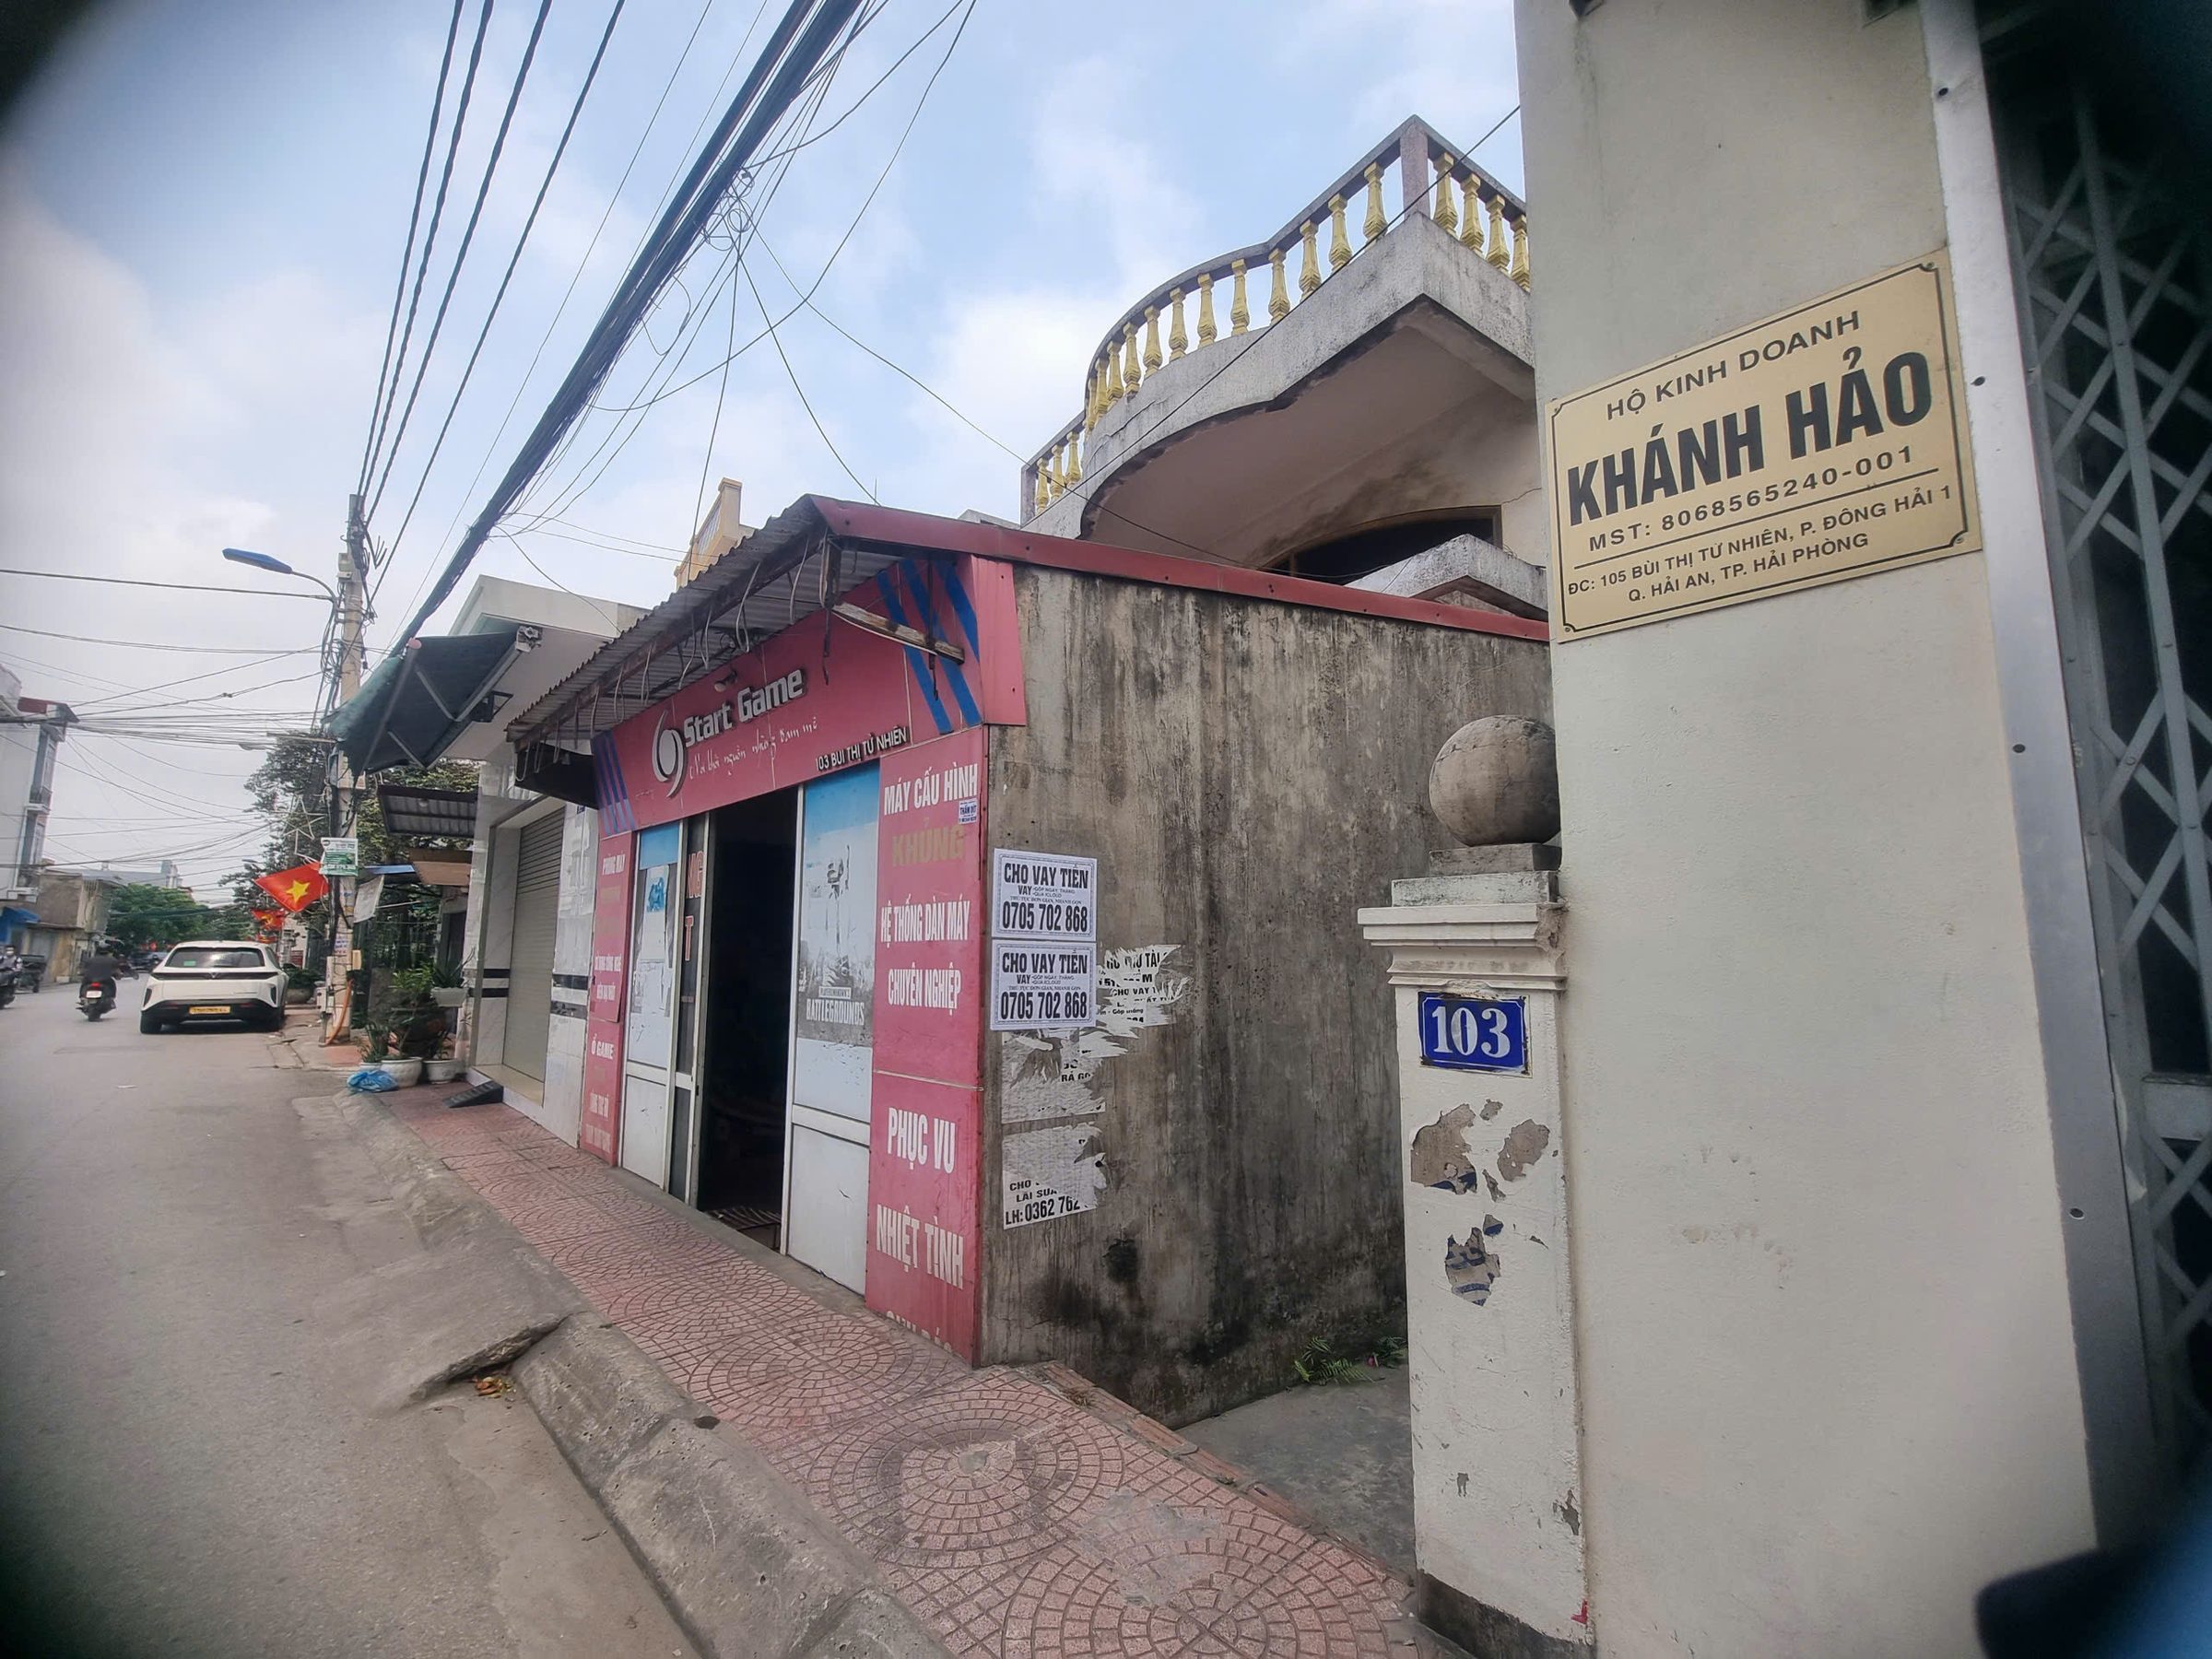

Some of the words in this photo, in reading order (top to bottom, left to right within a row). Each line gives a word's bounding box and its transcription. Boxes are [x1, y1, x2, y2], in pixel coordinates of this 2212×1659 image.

[1606, 387, 1647, 421] HỘ
[1655, 359, 1728, 403] KINH
[1738, 310, 1861, 372] DOANH
[1567, 404, 1765, 527] KHÁNH
[1784, 346, 1933, 461] HẢO
[1589, 523, 1651, 552] MST:
[1661, 445, 1911, 531] 8068565240-001
[1568, 579, 1596, 595] ĐC:
[1600, 570, 1628, 588] 105
[1631, 559, 1660, 580] BÙI
[1665, 552, 1694, 568] THỊ
[1698, 542, 1724, 562] TỪ
[1728, 527, 1794, 556] NHIÊN,
[1800, 521, 1817, 537] P.
[1822, 502, 1888, 531] ĐÔNG
[1894, 486, 1933, 512] HẢI
[1940, 485, 1951, 500] 1
[1628, 588, 1646, 603] Q.
[1651, 577, 1680, 597] HẢI
[1685, 571, 1716, 589] AN,
[1720, 562, 1747, 581] TP.
[1753, 548, 1787, 573] HẢI
[1792, 532, 1869, 564] PHÒNG
[683, 701, 734, 748] Start
[736, 668, 804, 724] Game
[815, 754, 830, 771] 103
[847, 744, 863, 762] THỊ
[877, 725, 908, 751] NHIÊN
[883, 777, 911, 816] MÁY
[913, 766, 940, 809] CẤU
[943, 761, 979, 802] HÌNH
[891, 817, 965, 867] KHỦNG
[1004, 862, 1030, 885] CHO
[1032, 865, 1057, 887] VAY
[1018, 885, 1032, 896] VAY
[880, 900, 893, 949] HỆ
[893, 892, 924, 944] THỐNG
[924, 894, 946, 943] DÀN
[946, 893, 971, 942] MÁY
[1003, 900, 1035, 931] 0705
[1039, 903, 1062, 932] 702
[1065, 904, 1088, 933] 868
[888, 961, 924, 1007] CHUYÊN
[924, 961, 962, 1017] NGHIỆP
[1002, 952, 1028, 974] CHO
[1031, 953, 1056, 974] VAY
[1017, 973, 1031, 984] VAY
[1000, 991, 1034, 1020] 0705
[1038, 991, 1062, 1019] 702
[1065, 991, 1088, 1019] 868
[1430, 1005, 1512, 1059] 103
[887, 1107, 929, 1171] PHỤC
[1009, 1180, 1032, 1192] CHO
[1024, 1198, 1055, 1223] 0362
[876, 1204, 921, 1273] NHIỆT
[924, 1215, 964, 1290] TÌNH
